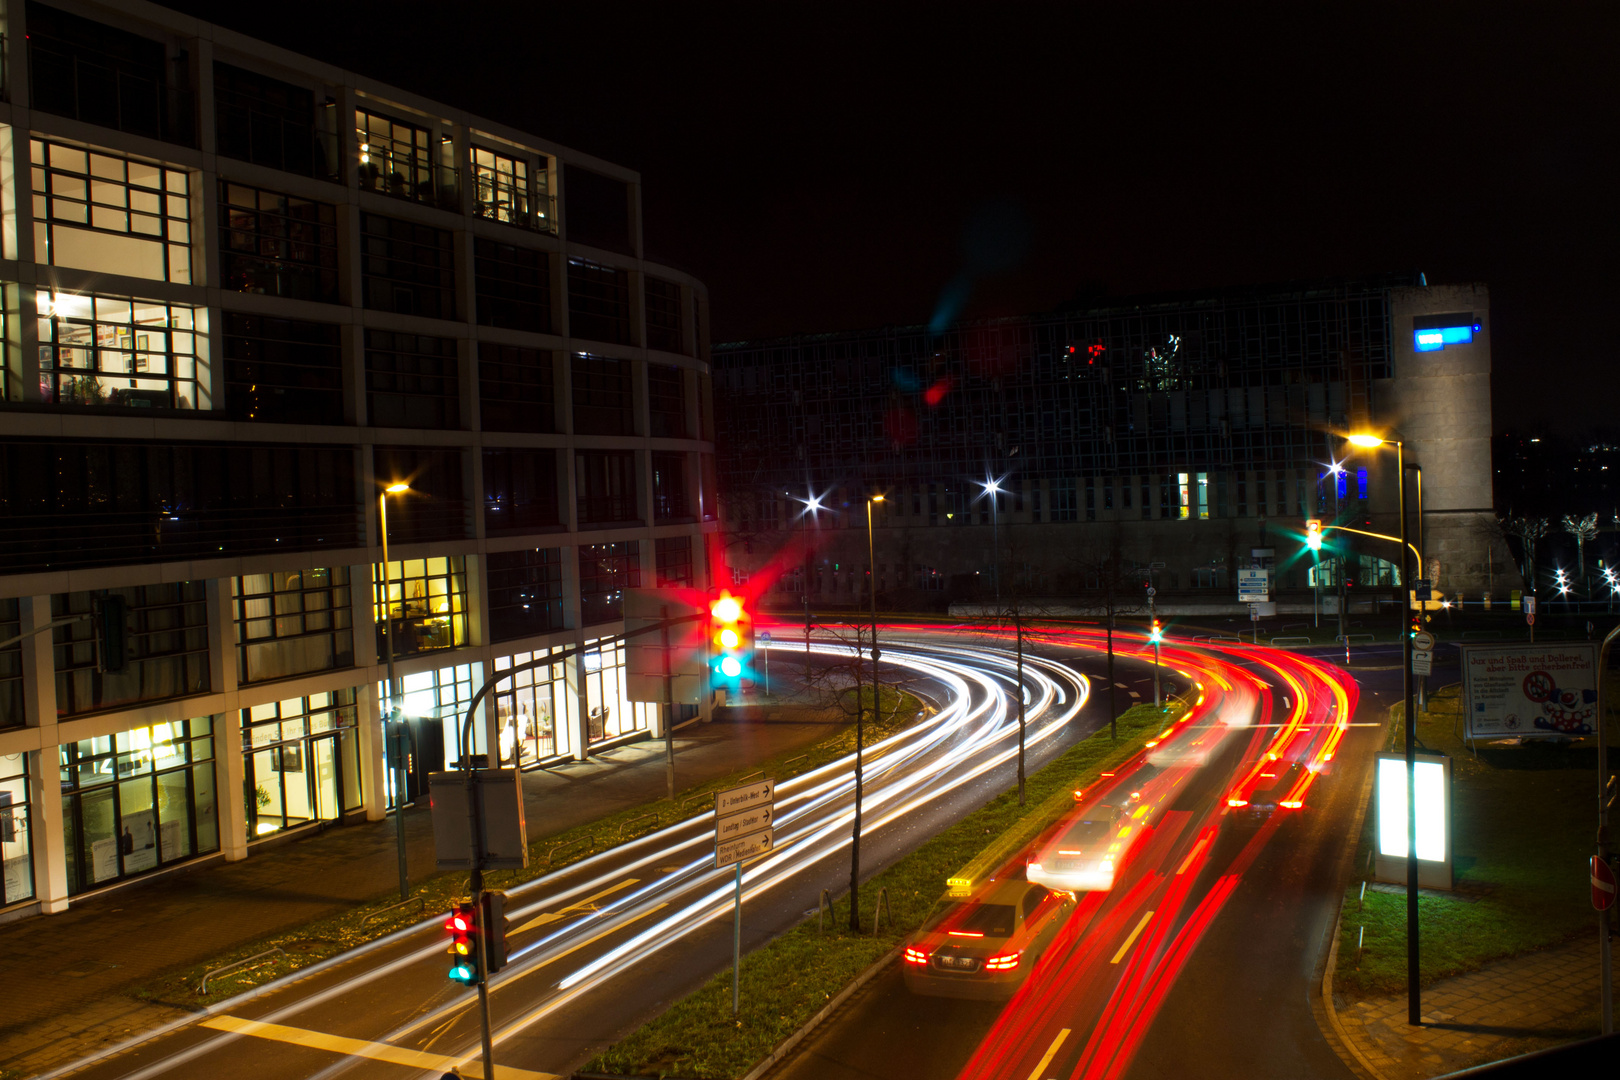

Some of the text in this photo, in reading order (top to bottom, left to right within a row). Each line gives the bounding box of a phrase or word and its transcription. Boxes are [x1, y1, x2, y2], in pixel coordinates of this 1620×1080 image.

[1470, 653, 1584, 666] Jux und Spaß und Dollerei,
[1486, 661, 1591, 673] aber bitte scherbenfrei!
[723, 799, 726, 807] D
[723, 822, 739, 833] Landtag
[720, 841, 745, 854] Rheinturm
[720, 853, 732, 864] WDR
